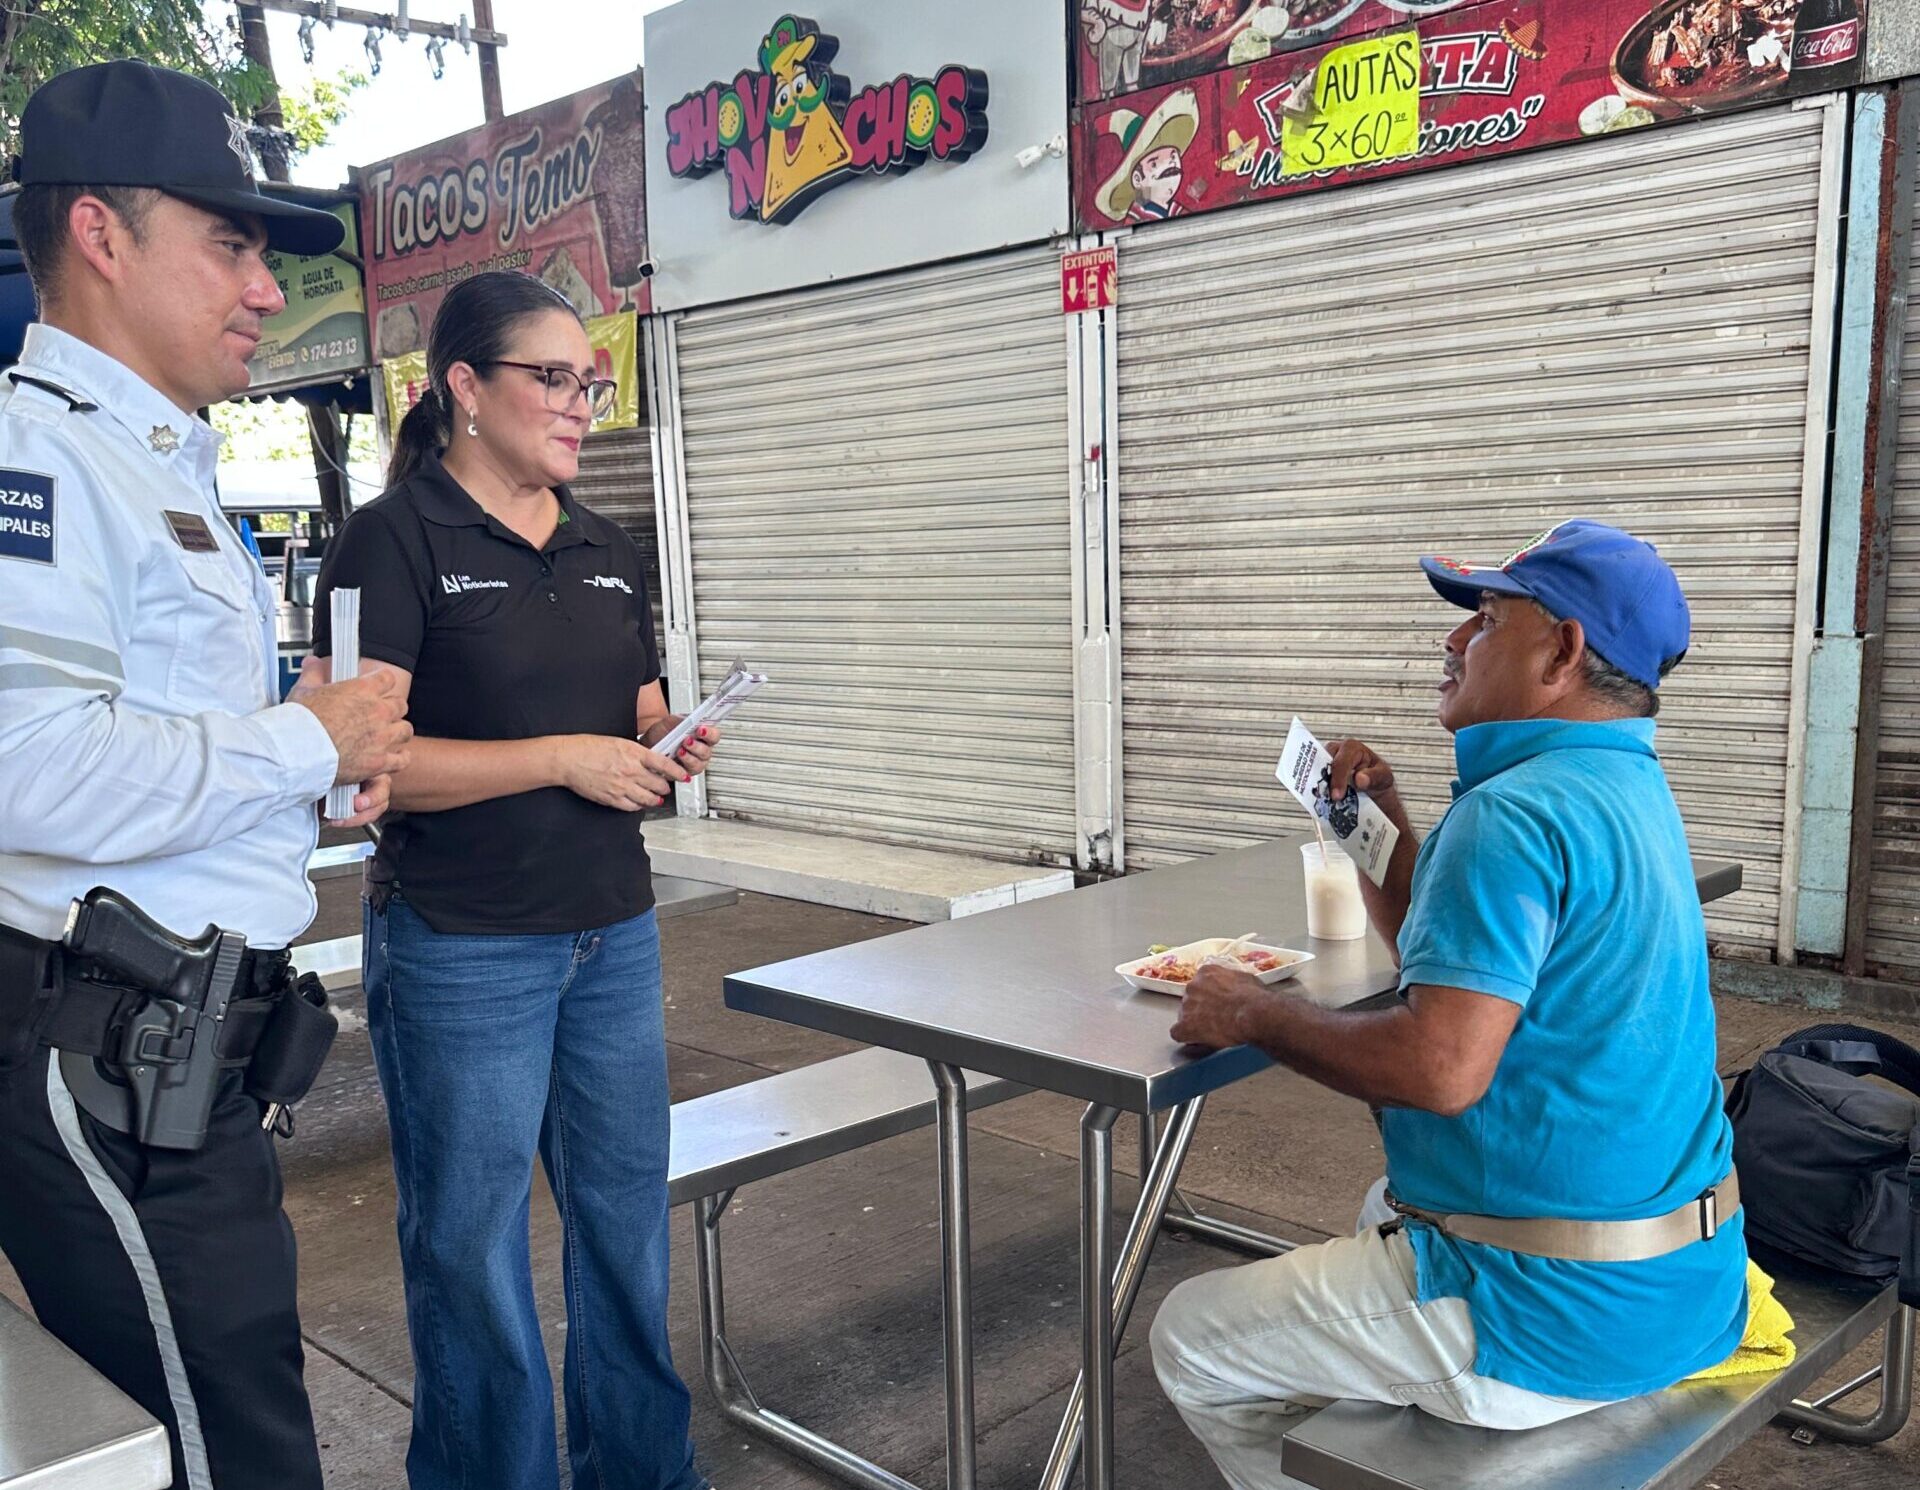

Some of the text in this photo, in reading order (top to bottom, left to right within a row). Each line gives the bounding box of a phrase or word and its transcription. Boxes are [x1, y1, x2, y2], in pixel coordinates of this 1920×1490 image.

[1794, 26, 1855, 60] Coca-Cola
[368, 125, 603, 259] Tacos Temo
[1064, 250, 1113, 271] EXTINTOR
[302, 266, 335, 285] AGUA DE
[377, 281, 403, 301] Tacos
[404, 277, 416, 295] de
[418, 272, 445, 290] carne
[446, 262, 474, 285] asada
[487, 253, 497, 272] al
[499, 248, 533, 271] pastor
[303, 280, 344, 300] HORCHATA
[310, 337, 357, 361] 174 23 13
